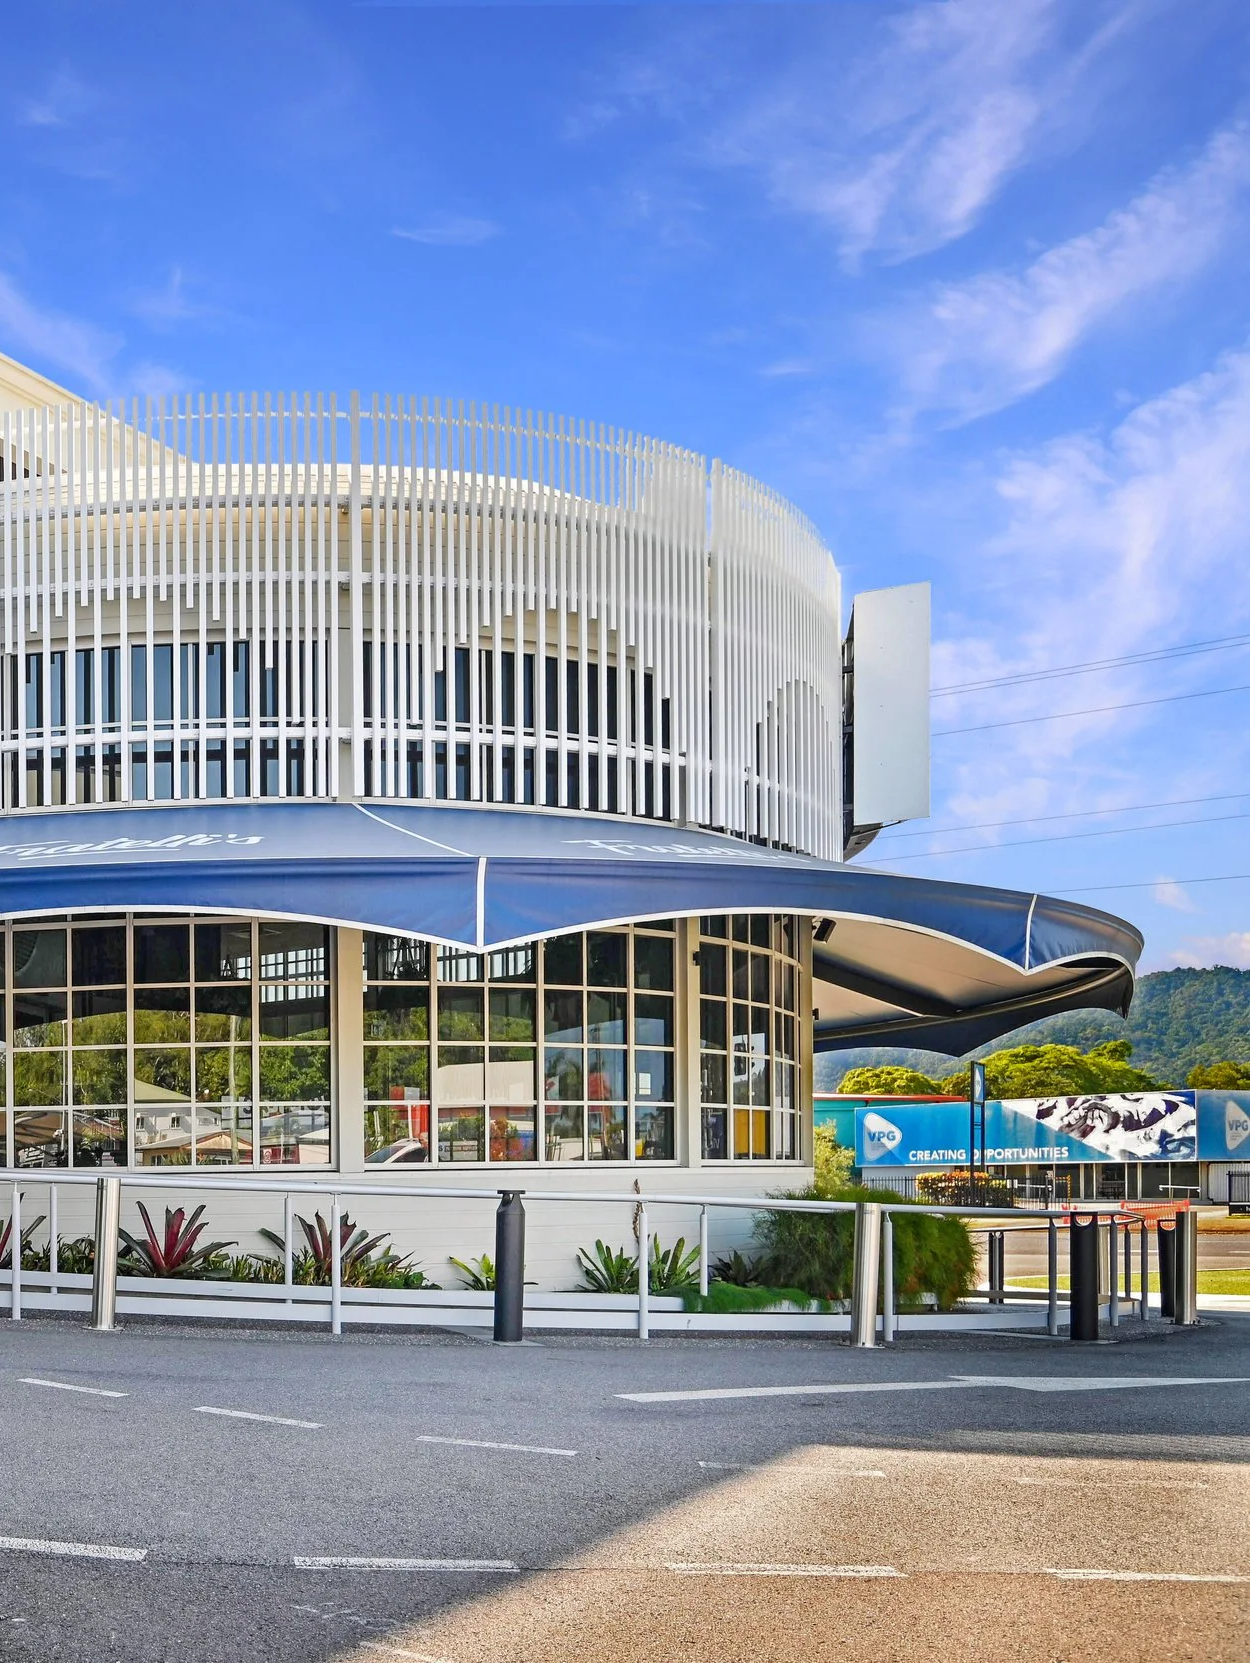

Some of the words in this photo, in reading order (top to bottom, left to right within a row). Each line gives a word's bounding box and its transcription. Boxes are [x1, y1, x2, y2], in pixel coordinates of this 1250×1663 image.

[1227, 1120, 1249, 1132] VPG
[867, 1130, 896, 1142] VPG
[909, 1149, 966, 1161] CREATING
